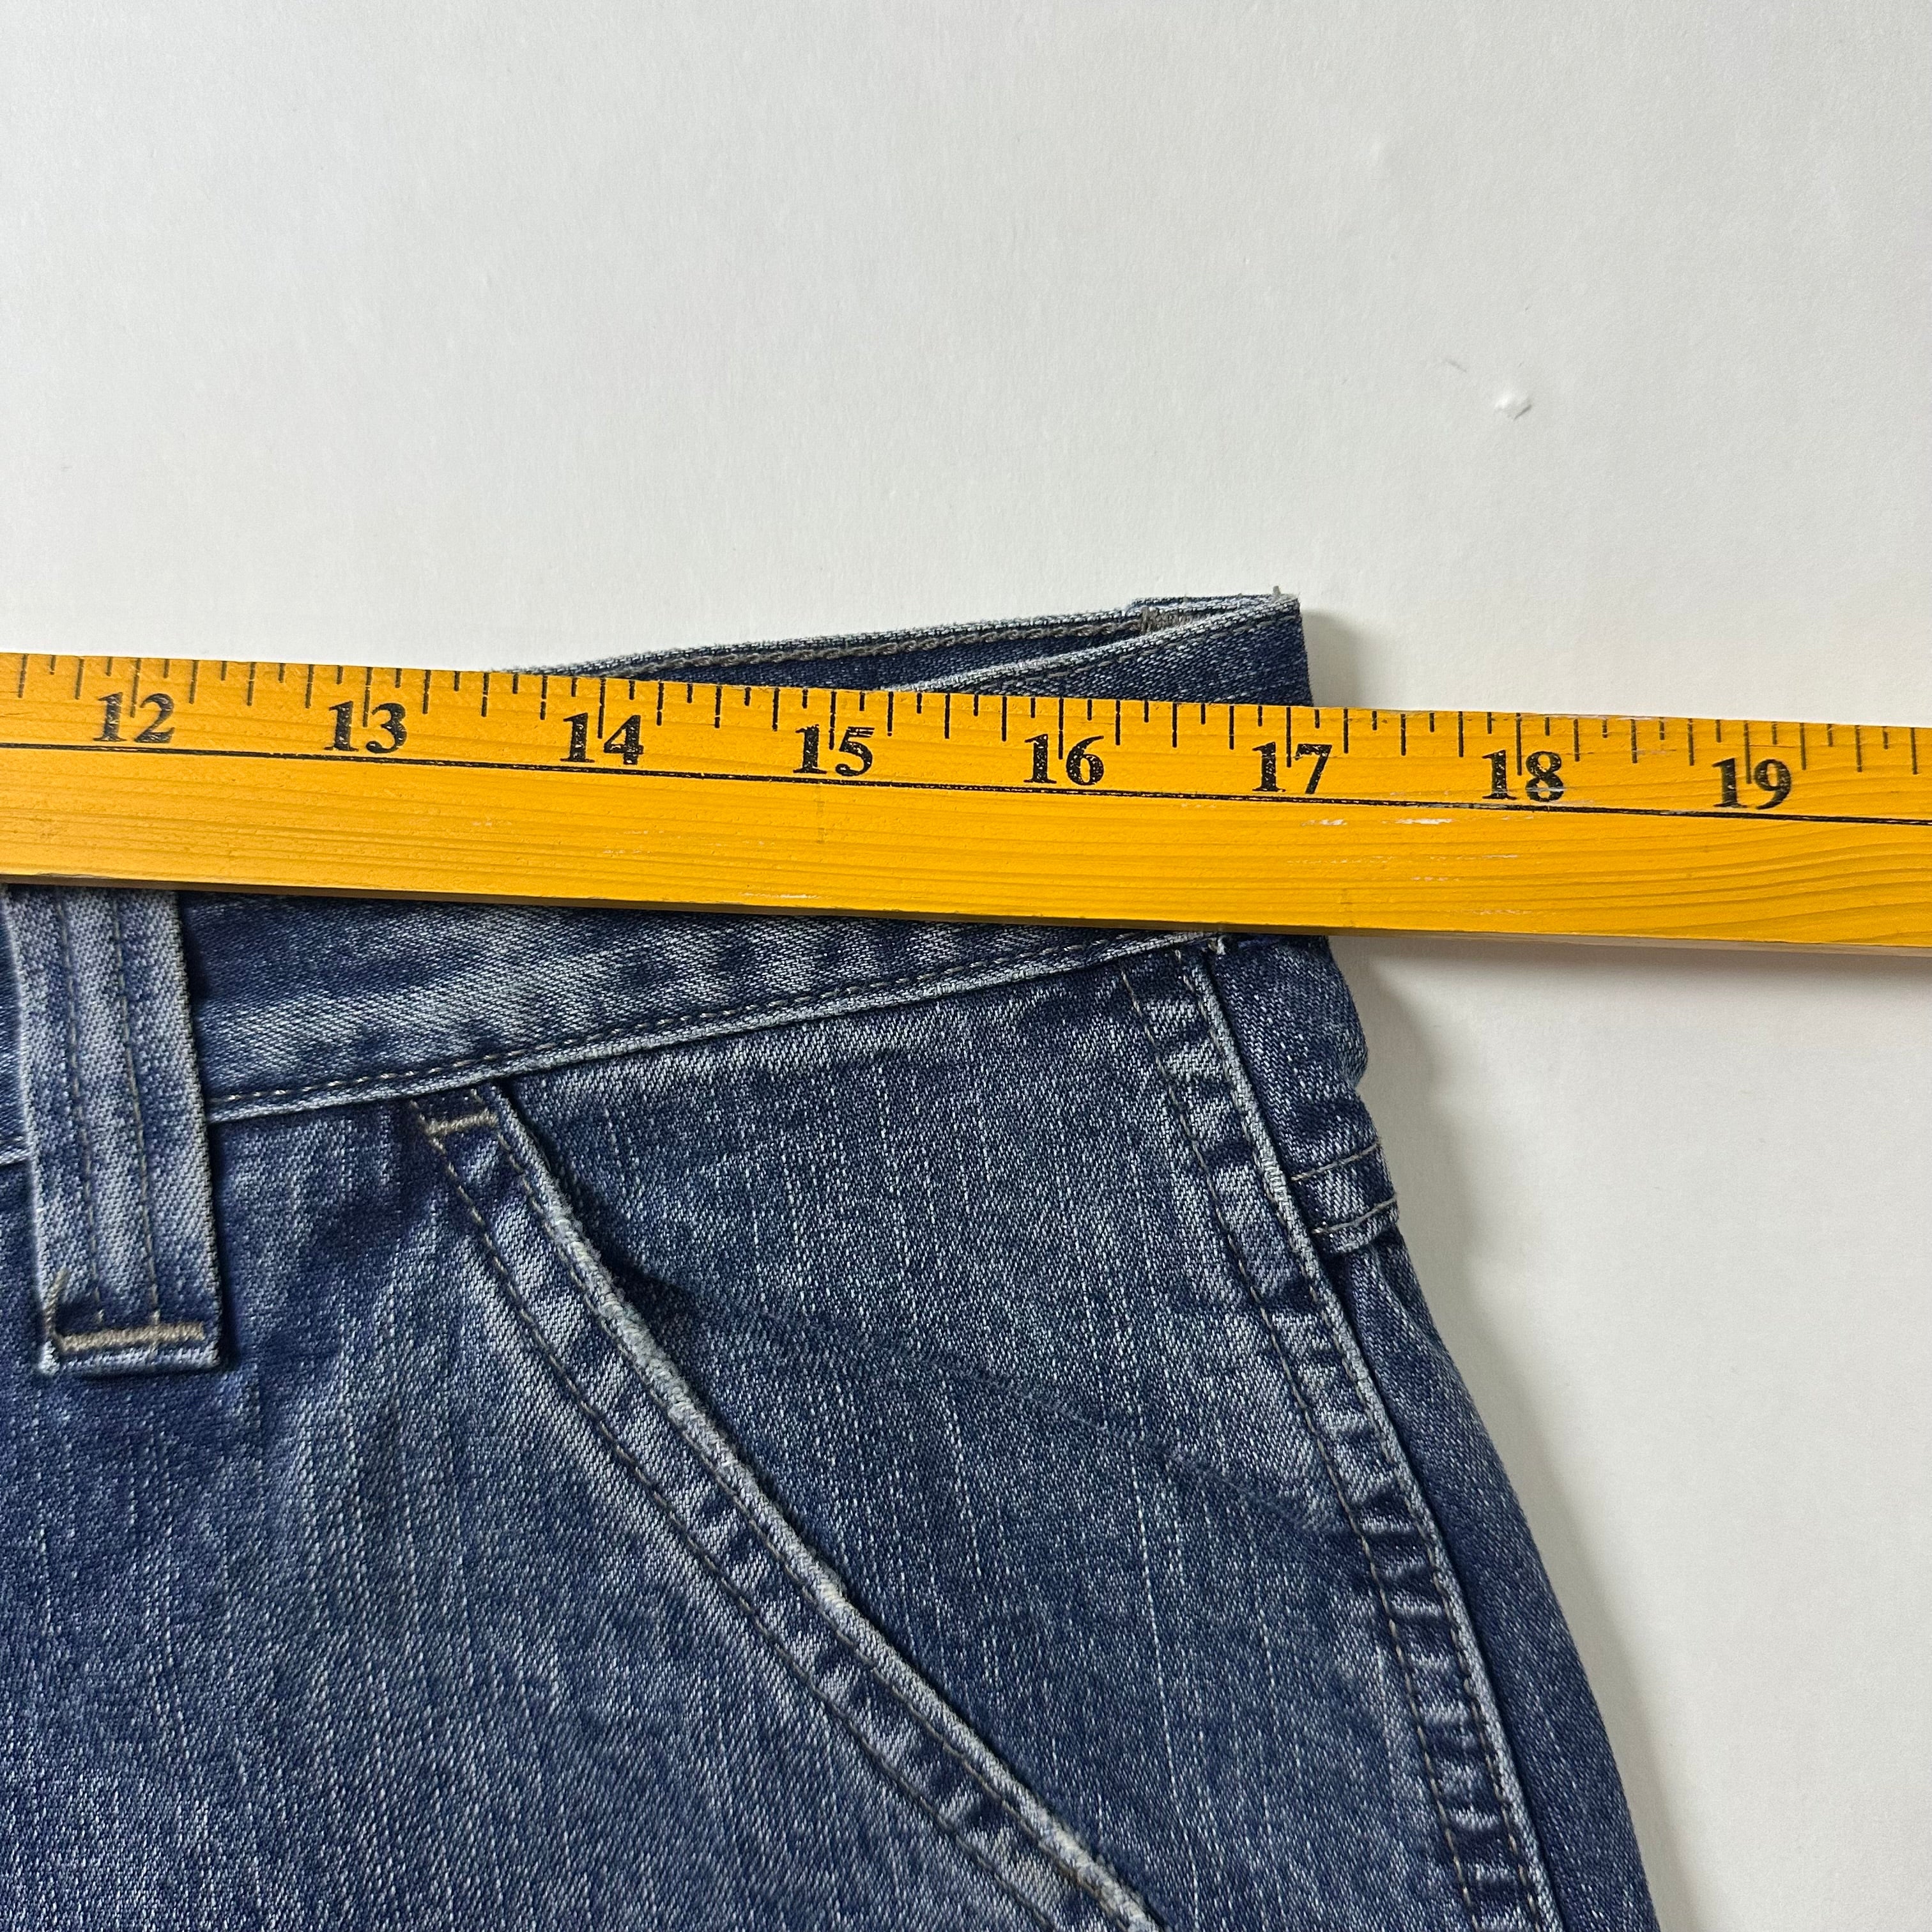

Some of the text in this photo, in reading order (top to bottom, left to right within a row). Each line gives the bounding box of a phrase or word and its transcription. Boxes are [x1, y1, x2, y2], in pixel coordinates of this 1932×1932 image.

[94, 692, 1791, 810] 12 13 14 15 16 17 18 19
